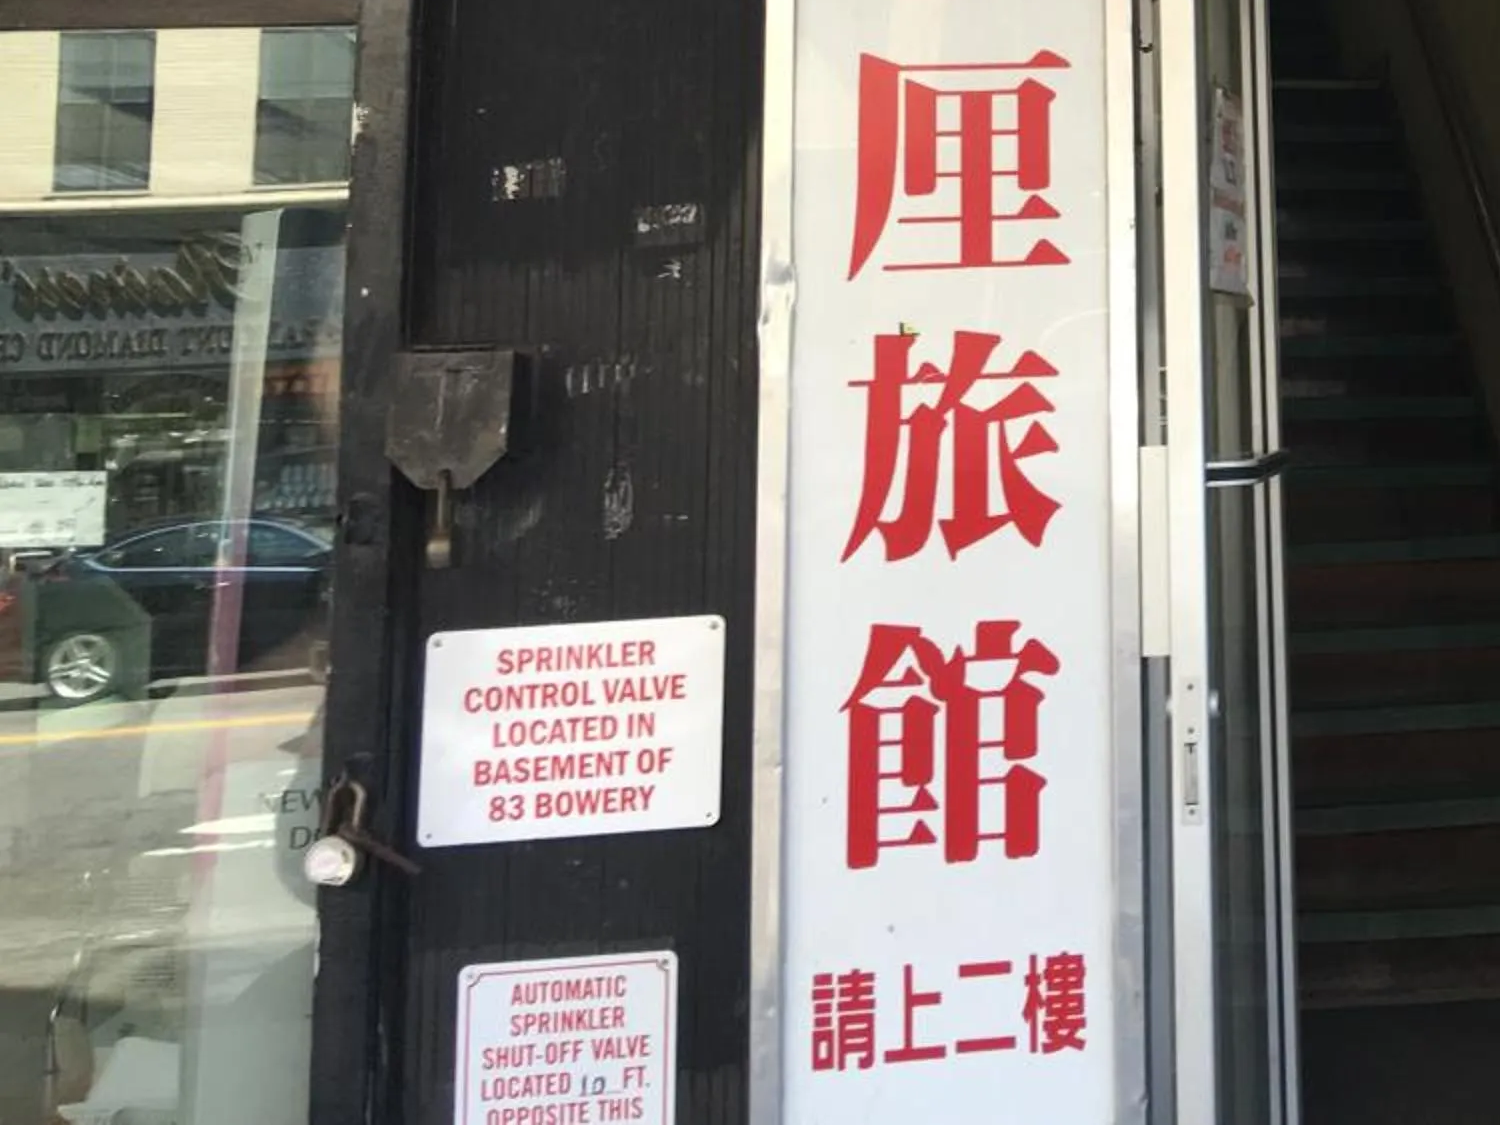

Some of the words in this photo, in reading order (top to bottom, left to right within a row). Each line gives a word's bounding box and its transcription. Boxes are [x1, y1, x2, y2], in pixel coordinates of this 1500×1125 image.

[497, 640, 657, 675] SPRINKLER
[464, 680, 596, 714] CONTROL
[602, 674, 688, 704] VALVE
[492, 715, 618, 748] LOCATED
[626, 712, 656, 738] IN
[473, 750, 631, 787] BASEMENT
[636, 747, 674, 775] OF
[488, 794, 526, 823] 83
[535, 784, 656, 820] BOWERY
[511, 974, 627, 1006] AUTOMATIC
[510, 1006, 625, 1037] SPRINKLER
[810, 952, 1087, 1072] 請上二樓
[482, 1040, 584, 1070] SHUT-OFF
[591, 1034, 651, 1062] VALVE
[481, 1072, 571, 1102] LOCATED
[622, 1066, 651, 1091] FT.
[487, 1101, 591, 1125] OPPOSITE
[598, 1096, 644, 1122] THIS
